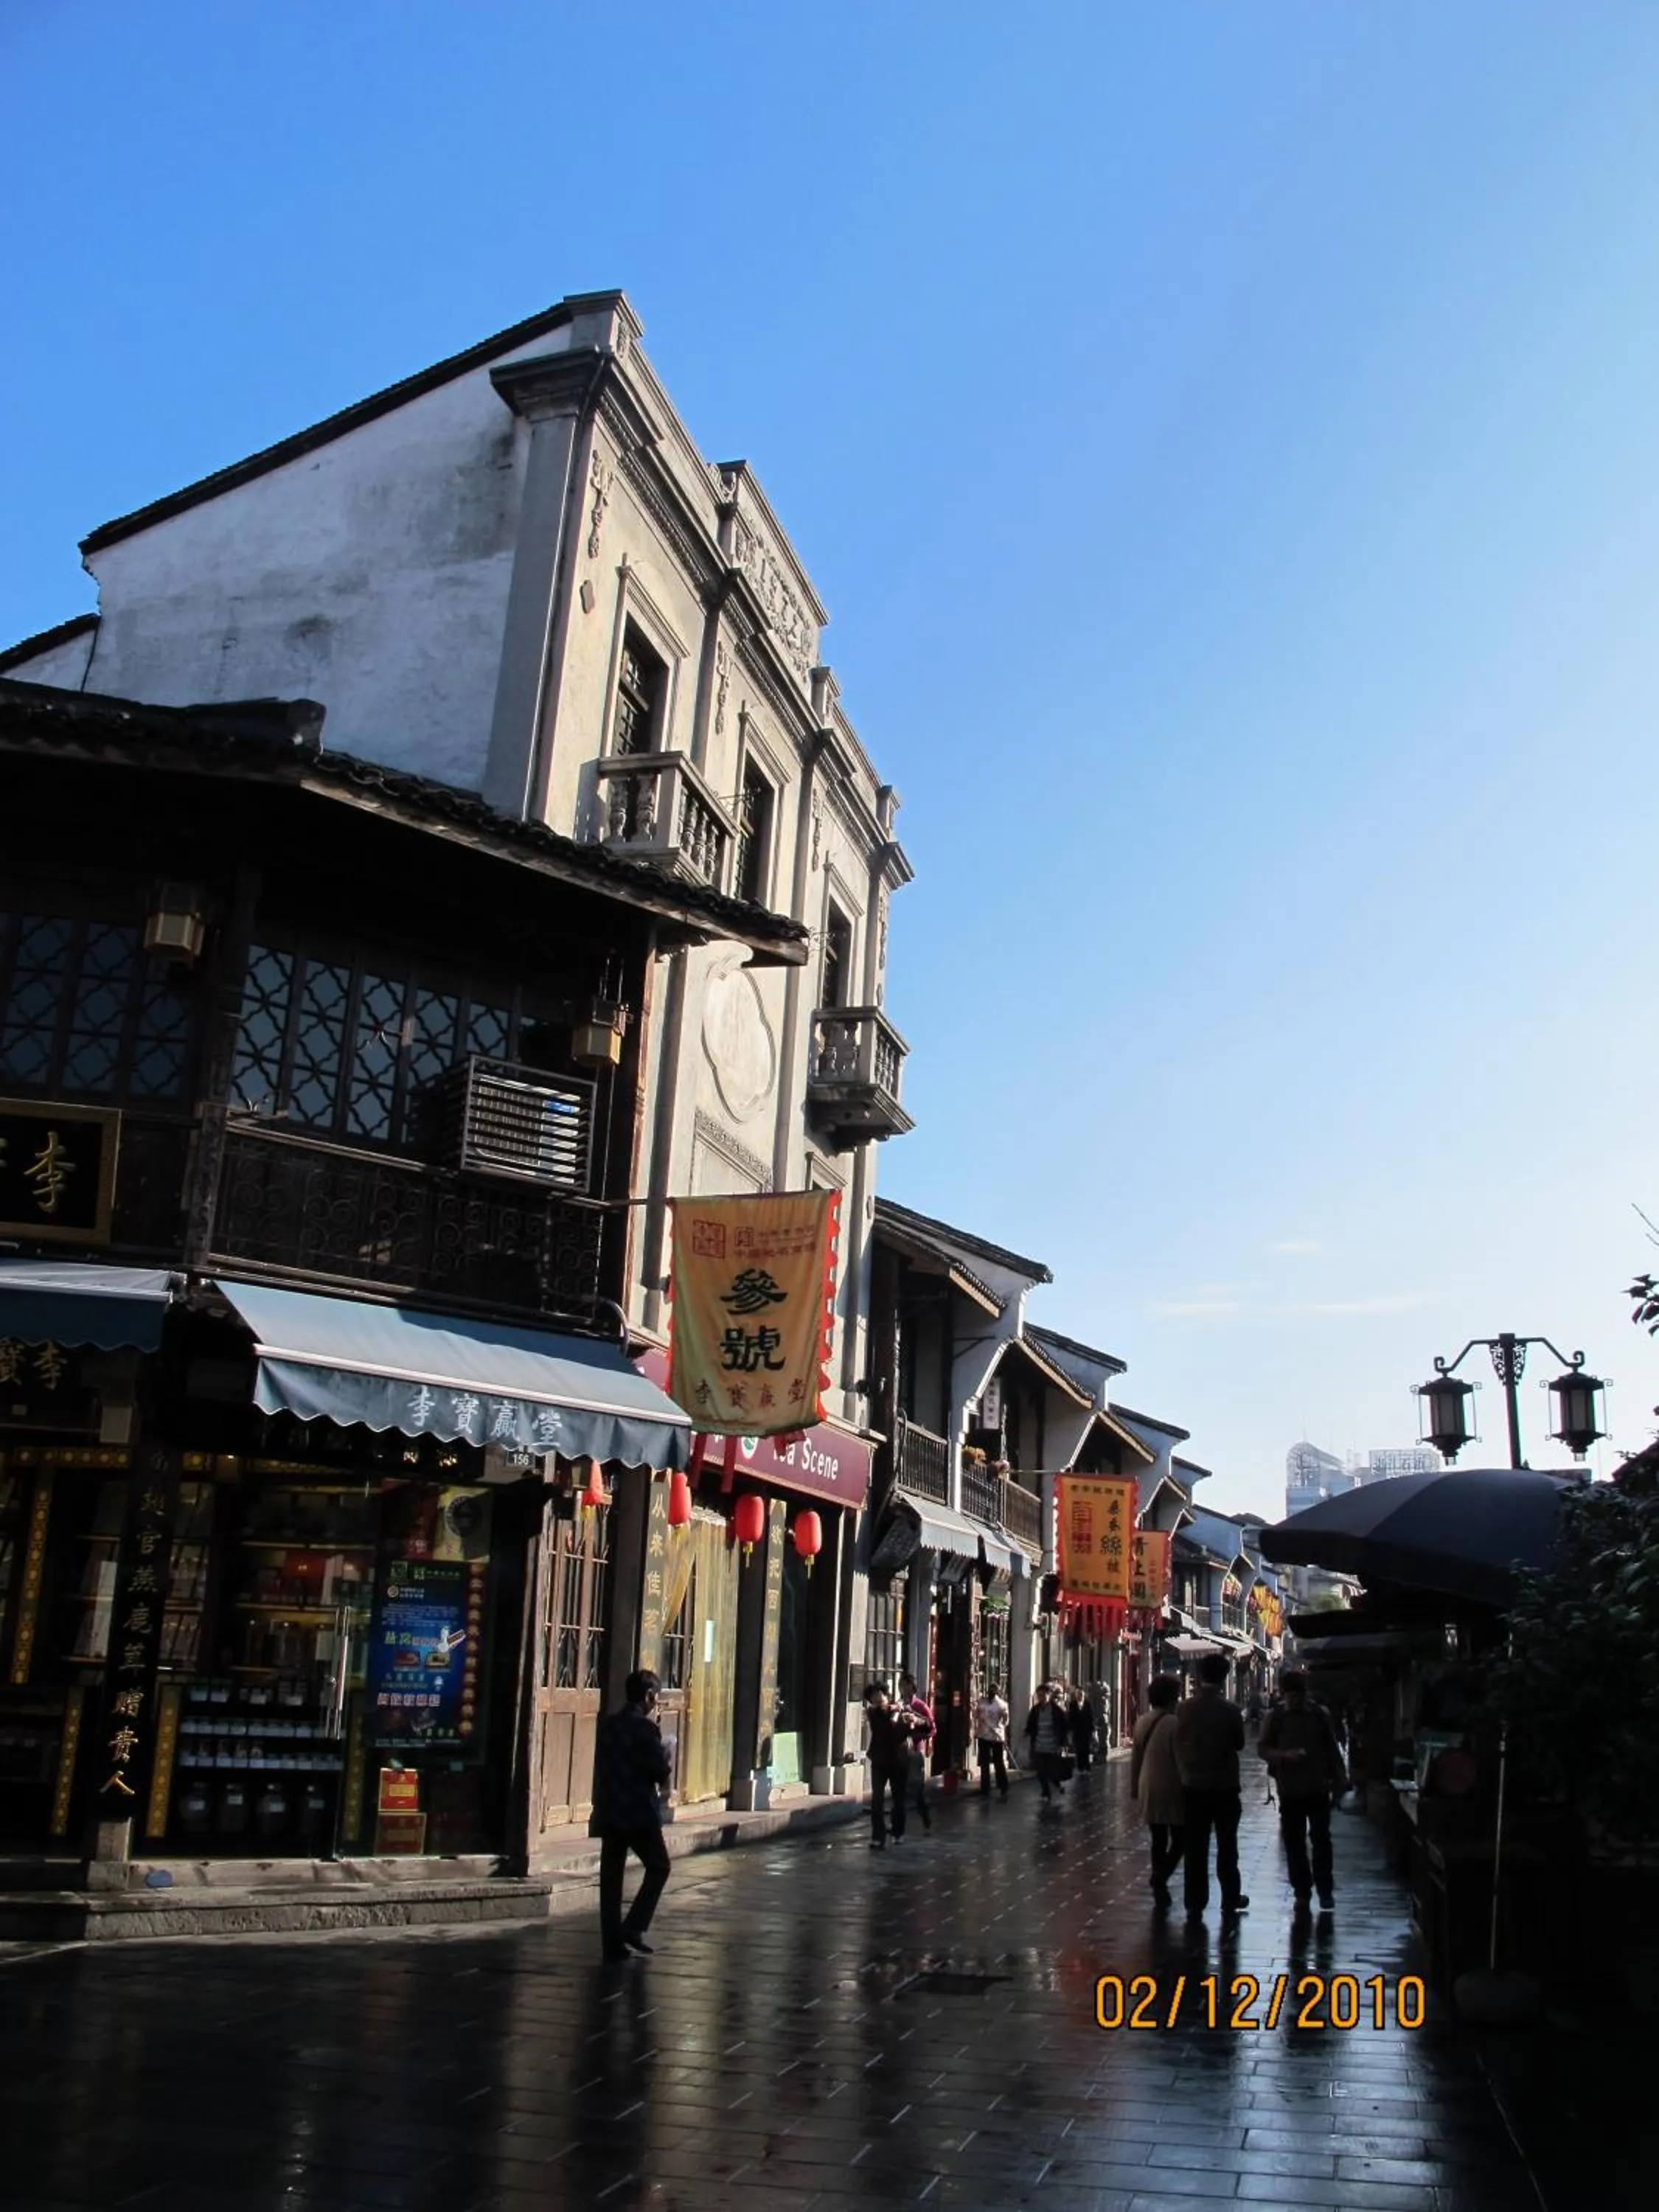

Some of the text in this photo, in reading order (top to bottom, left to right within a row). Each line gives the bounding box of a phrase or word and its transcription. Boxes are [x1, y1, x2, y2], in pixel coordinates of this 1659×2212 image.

[0, 1131, 76, 1213] 李
[512, 1453, 529, 1466] 156
[801, 1437, 838, 1481] Scene
